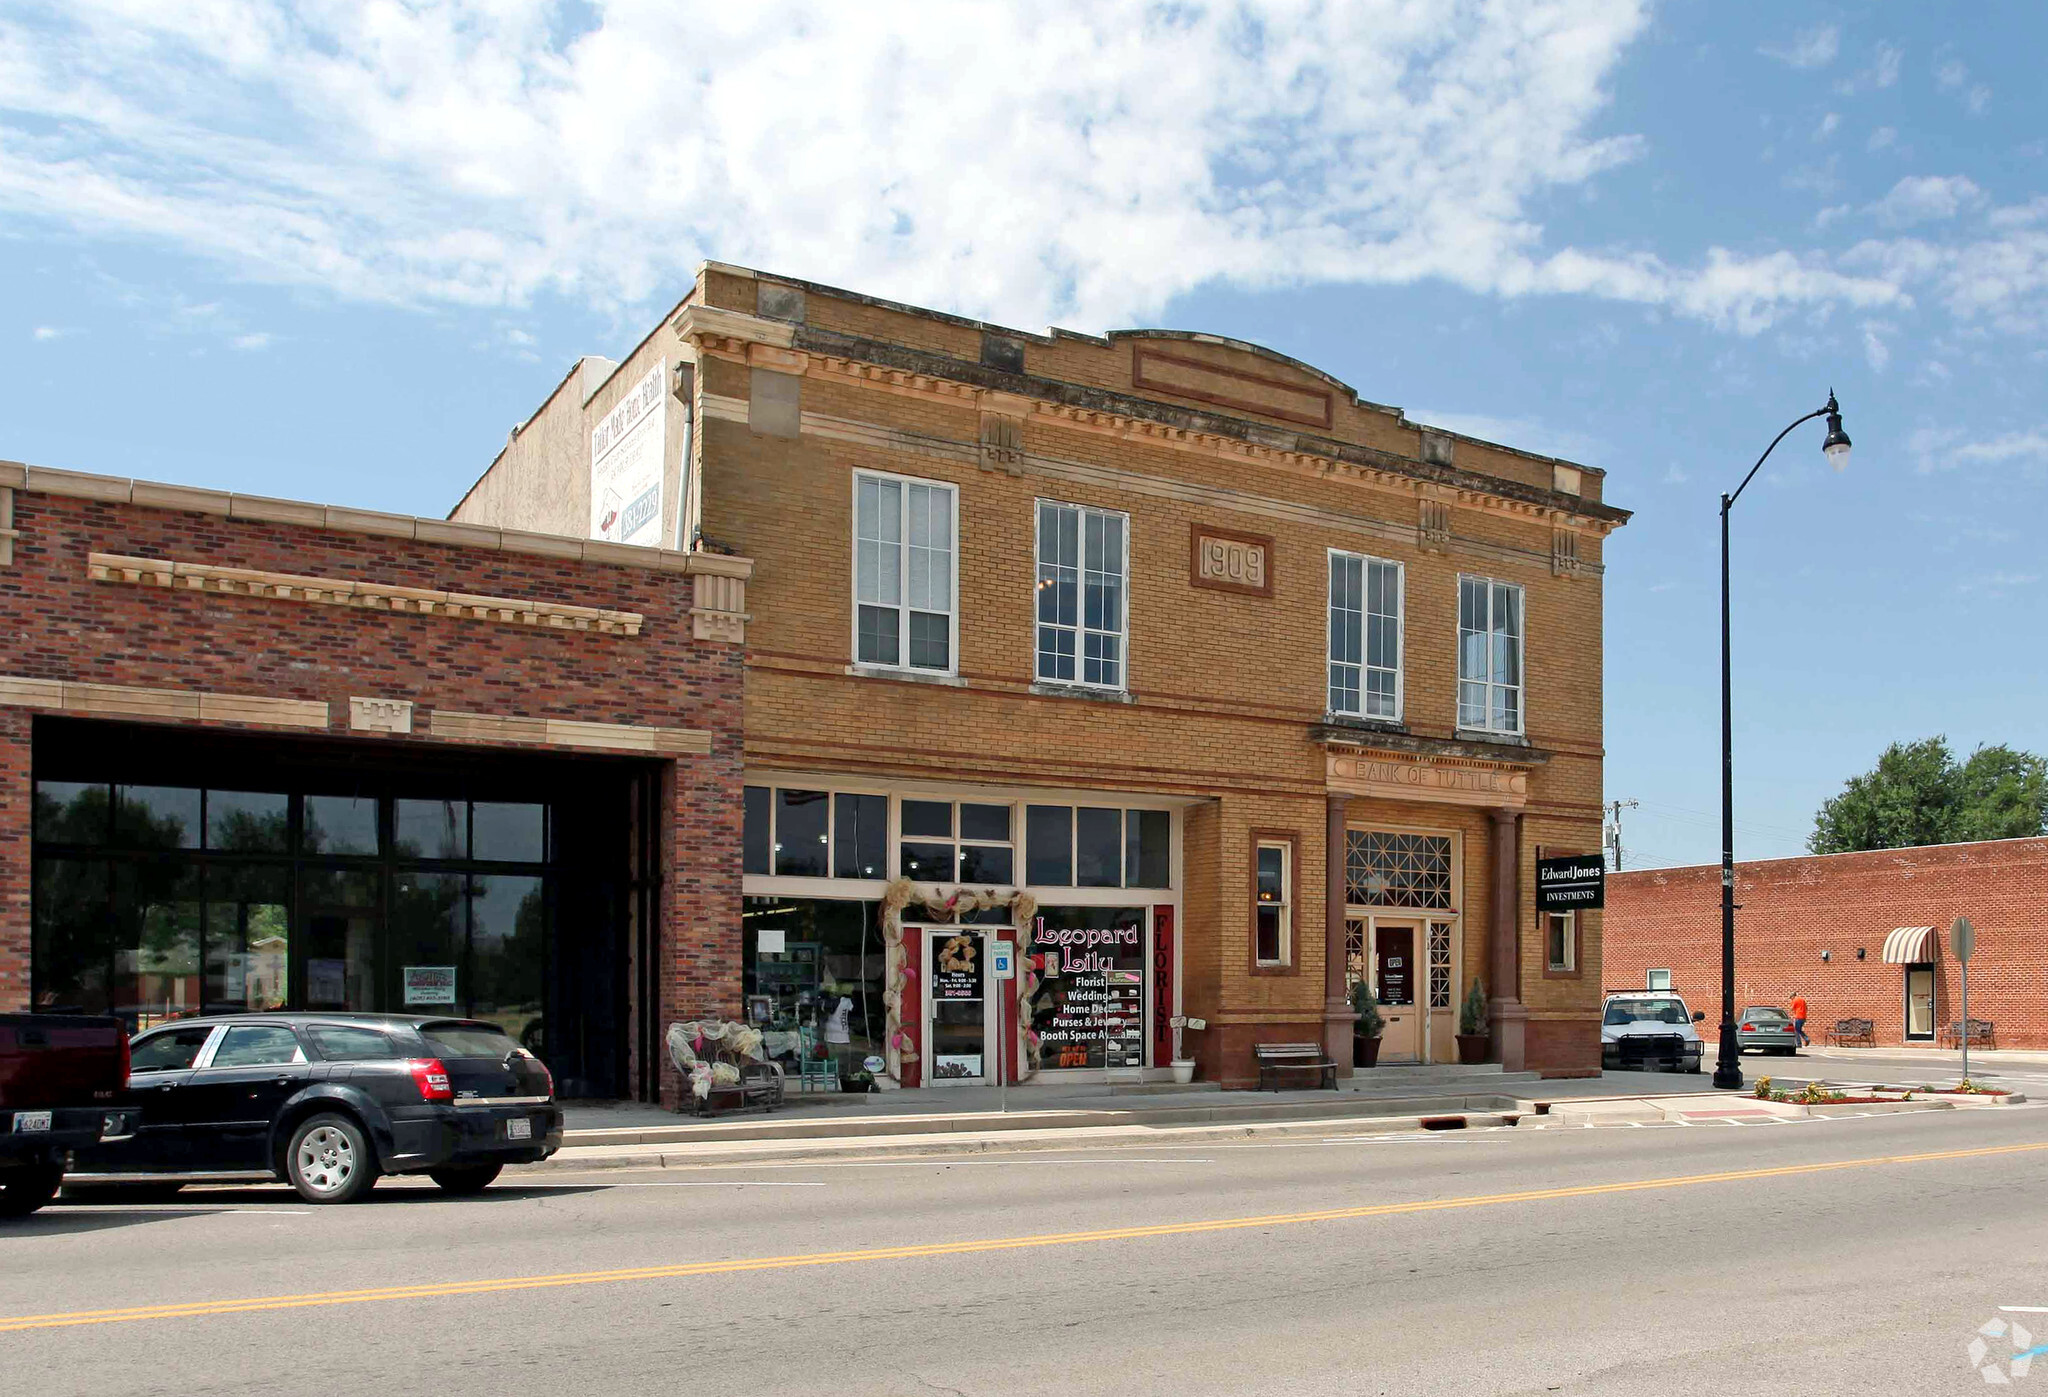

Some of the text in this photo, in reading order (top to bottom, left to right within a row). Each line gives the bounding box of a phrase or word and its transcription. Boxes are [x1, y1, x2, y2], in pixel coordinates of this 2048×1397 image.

[643, 370, 662, 410] Health
[1202, 539, 1262, 582] 1909
[1355, 760, 1499, 792] BANK OF TUTTLE
[1546, 890, 1595, 901] INVESTMENTS
[1034, 916, 1138, 948] Leopard
[1061, 946, 1113, 976] Lily
[1076, 977, 1105, 987] Florist
[1155, 914, 1168, 1043] FLORIST
[1063, 1004, 1090, 1014] Home
[1053, 1018, 1083, 1027] Purses
[1085, 1018, 1091, 1026] &
[1040, 1031, 1068, 1040] Booth
[1070, 1031, 1096, 1042] Space
[1060, 1053, 1087, 1067] OPEN
